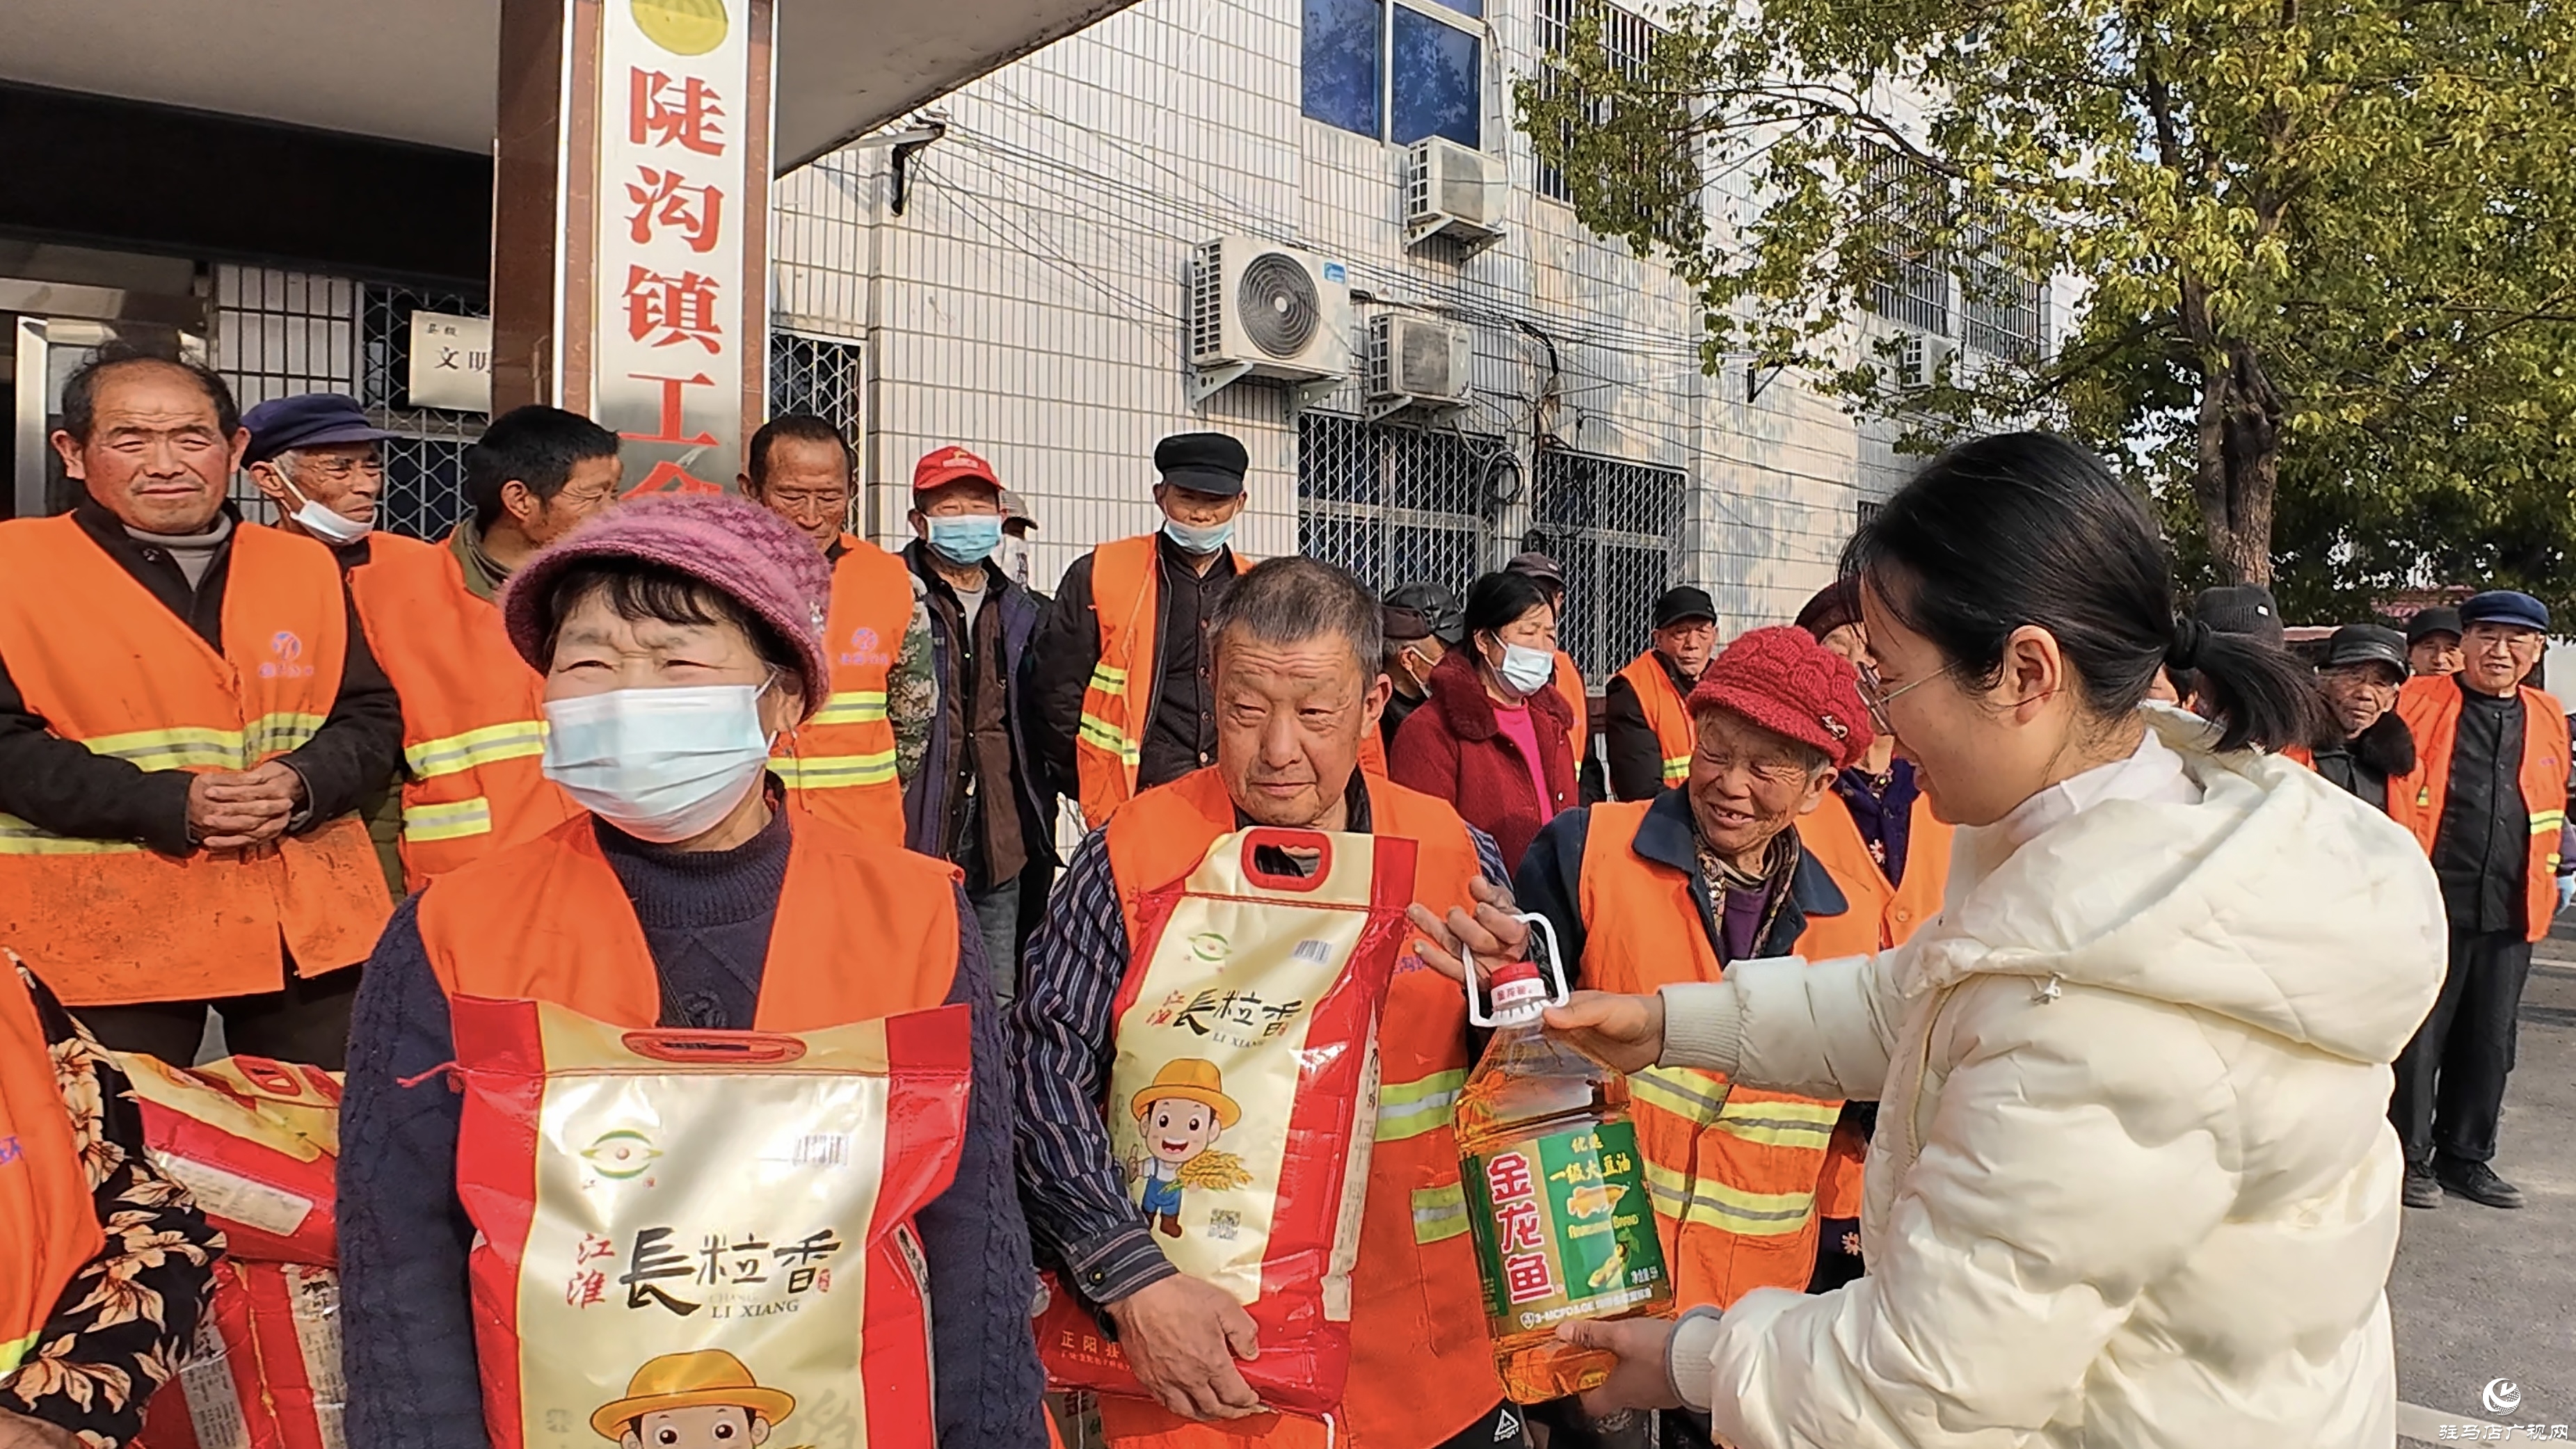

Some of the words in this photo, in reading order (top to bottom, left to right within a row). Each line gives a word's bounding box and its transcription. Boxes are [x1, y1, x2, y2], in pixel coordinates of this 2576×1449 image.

[1496, 988, 1527, 1002] 金龙鱼
[1213, 1032, 1226, 1043] LI
[1549, 1152, 1631, 1184] 一级大豆油
[1487, 1151, 1555, 1305] 金龙鱼
[566, 1232, 616, 1310] 江淮
[618, 1226, 842, 1317] 長粒香
[711, 1305, 730, 1320] LI
[740, 1299, 800, 1319] XIANG
